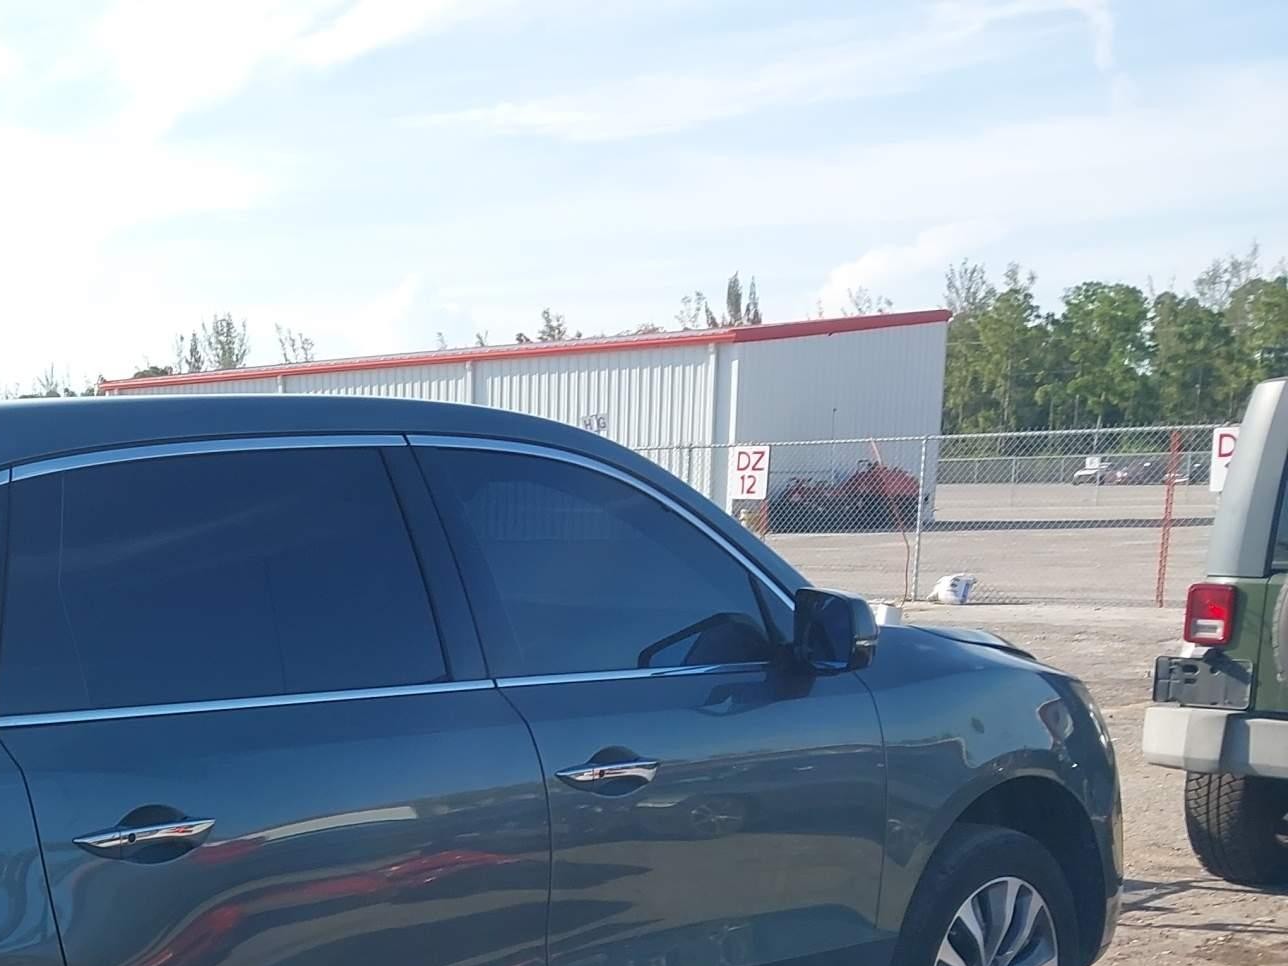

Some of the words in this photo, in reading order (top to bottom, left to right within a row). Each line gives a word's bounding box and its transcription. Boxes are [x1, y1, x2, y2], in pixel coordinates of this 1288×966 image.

[1217, 433, 1237, 458] D
[736, 451, 766, 471] DZ
[740, 474, 757, 494] 12
